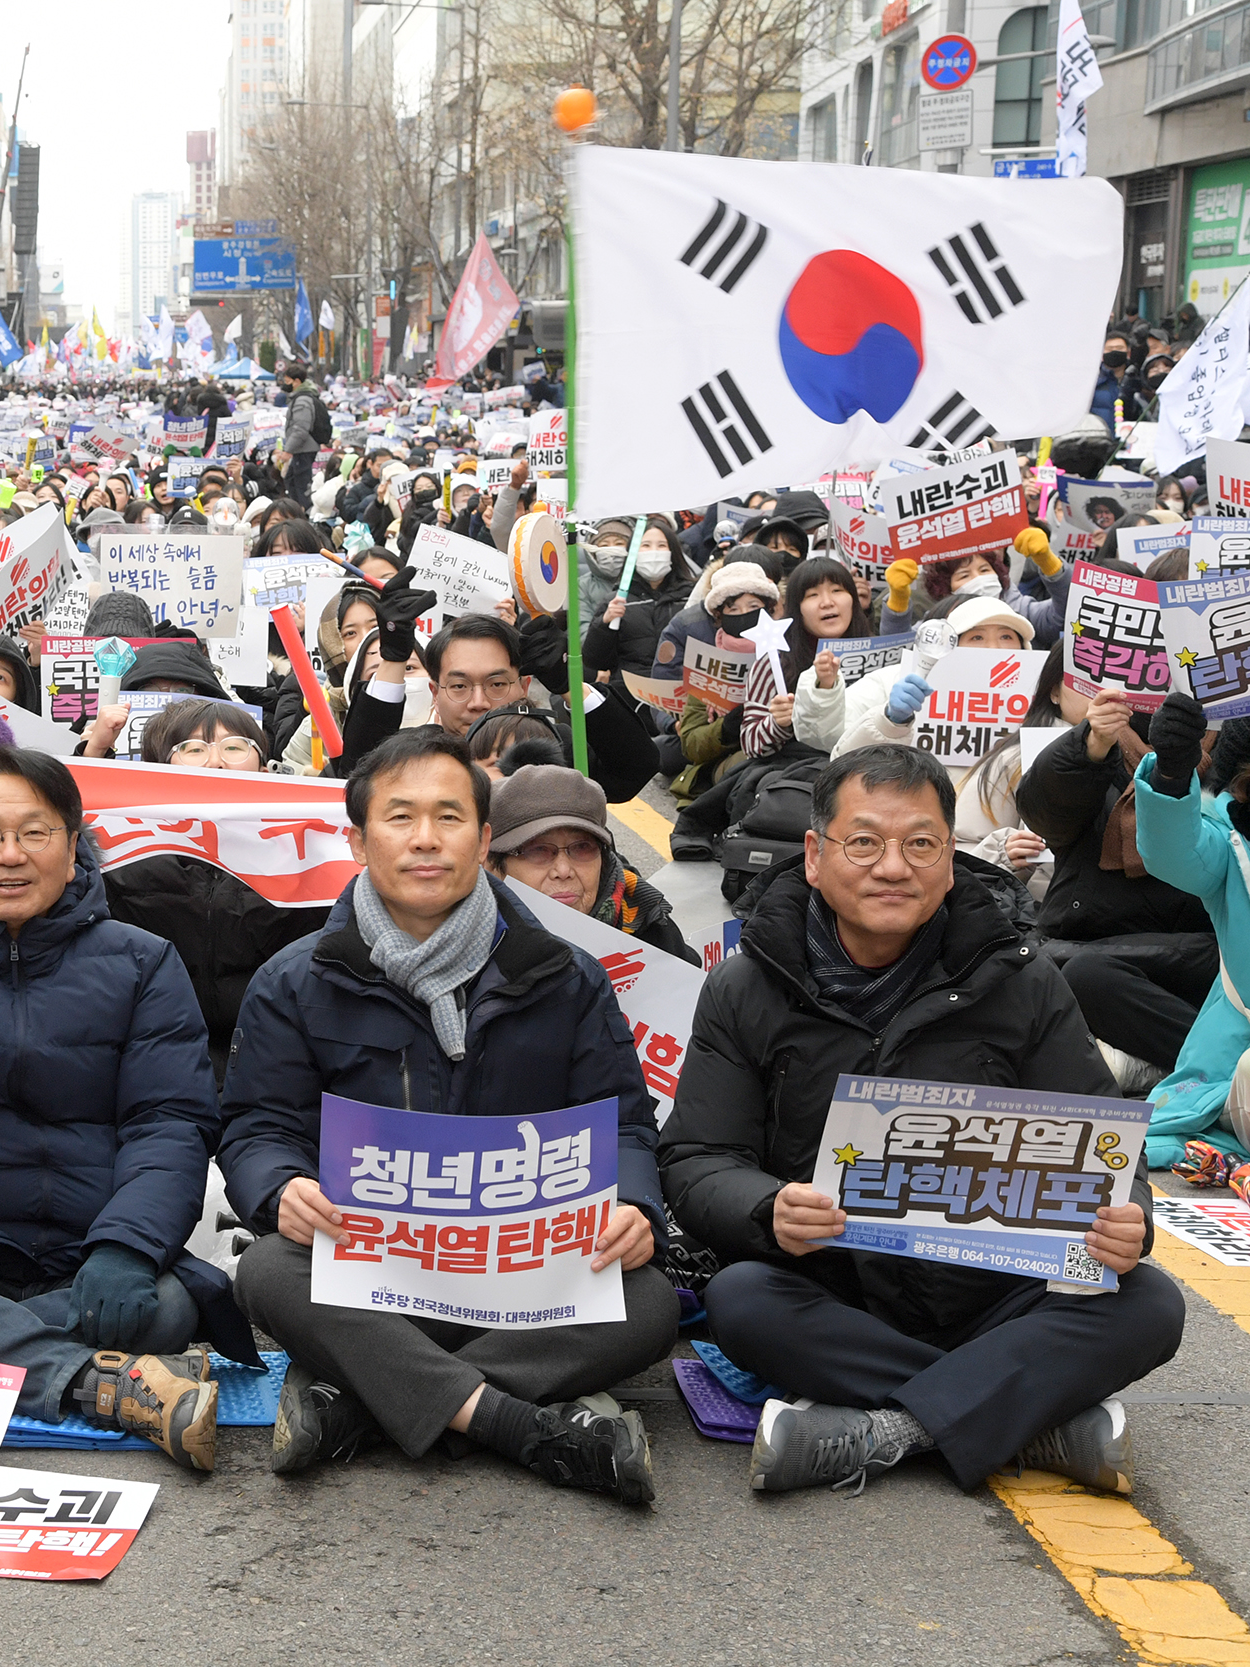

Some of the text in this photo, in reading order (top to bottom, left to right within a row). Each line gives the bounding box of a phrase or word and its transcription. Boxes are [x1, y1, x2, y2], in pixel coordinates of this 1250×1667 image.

[896, 461, 1009, 521] 내란수괴
[896, 490, 1021, 551] 윤석열 탄핵!
[109, 542, 202, 564] 이 세상 속에서
[421, 529, 450, 548] 김건희
[1138, 536, 1187, 551] 내란범죄자
[108, 565, 218, 592] 반복되는 슬픔
[1079, 567, 1138, 596] 내란공범
[1079, 596, 1164, 648] 국민
[823, 639, 872, 651] 내란범죄자
[696, 653, 749, 684] 내란
[117, 692, 173, 711] 란범죄자
[929, 691, 1032, 724] 내란의
[847, 1080, 977, 1108] 내란범죄자
[1024, 1103, 1040, 1112] 즉각
[1041, 1104, 1057, 1113] 퇴진
[1059, 1106, 1097, 1116] 사회대개혁
[1099, 1108, 1144, 1120] 광주비상행동
[888, 1114, 1084, 1166] 윤석열
[842, 1160, 1108, 1225] 탄핵체포
[333, 1198, 611, 1275] 윤석열 탄핵!
[844, 1232, 897, 1248] 후원계좌 안내
[913, 1240, 959, 1260] 광주은행
[961, 1249, 1060, 1276] 064-107-024020
[370, 1290, 576, 1324] 민주당 전국청년위원회·대학생위원회
